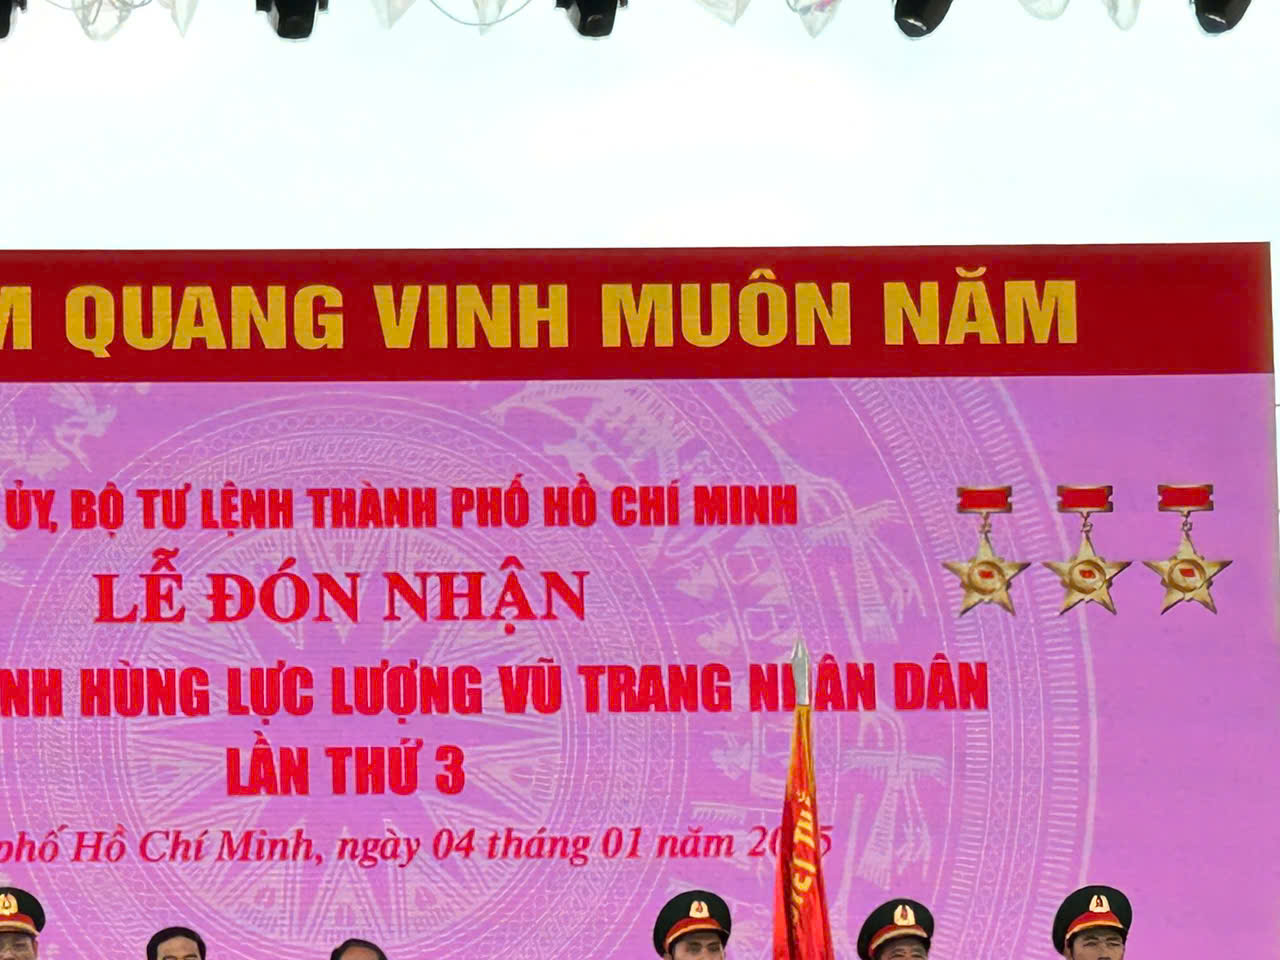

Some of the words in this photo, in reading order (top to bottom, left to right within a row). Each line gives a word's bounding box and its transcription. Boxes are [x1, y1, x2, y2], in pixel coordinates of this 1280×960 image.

[65, 285, 344, 358] QUANG
[374, 284, 569, 349] VINH
[602, 269, 852, 347] MUÔN
[884, 266, 1077, 345] NĂM
[5, 480, 58, 533] ỦY,
[70, 482, 124, 537] BỘ
[136, 482, 193, 530] TƯ
[201, 480, 294, 535] LỆNH
[305, 480, 437, 529] THÀNH
[451, 473, 530, 528] PHỐ
[544, 473, 597, 528] HỒ
[611, 480, 680, 527] CHÍ
[693, 484, 798, 526] MINH
[93, 547, 187, 624] LỄ
[206, 557, 362, 624] ĐÓN
[383, 556, 589, 633] NHẬN
[80, 660, 209, 717] HÙNG
[227, 659, 315, 726] LỰC
[331, 658, 483, 725] LƯỢNG
[498, 656, 562, 714] VŨ
[577, 663, 732, 713] TRANG
[893, 653, 989, 711] DÂN
[226, 730, 310, 796] LẦN
[324, 738, 424, 796] THỨ
[435, 745, 466, 795] 3
[70, 824, 127, 862] Hồ
[139, 829, 208, 862] Chí
[216, 828, 323, 865] Minh,
[338, 829, 421, 868] ngày
[433, 828, 475, 860] 04
[488, 827, 591, 866] tháng
[602, 827, 641, 858] 01
[656, 827, 734, 858] năm
[748, 825, 834, 858] 205
